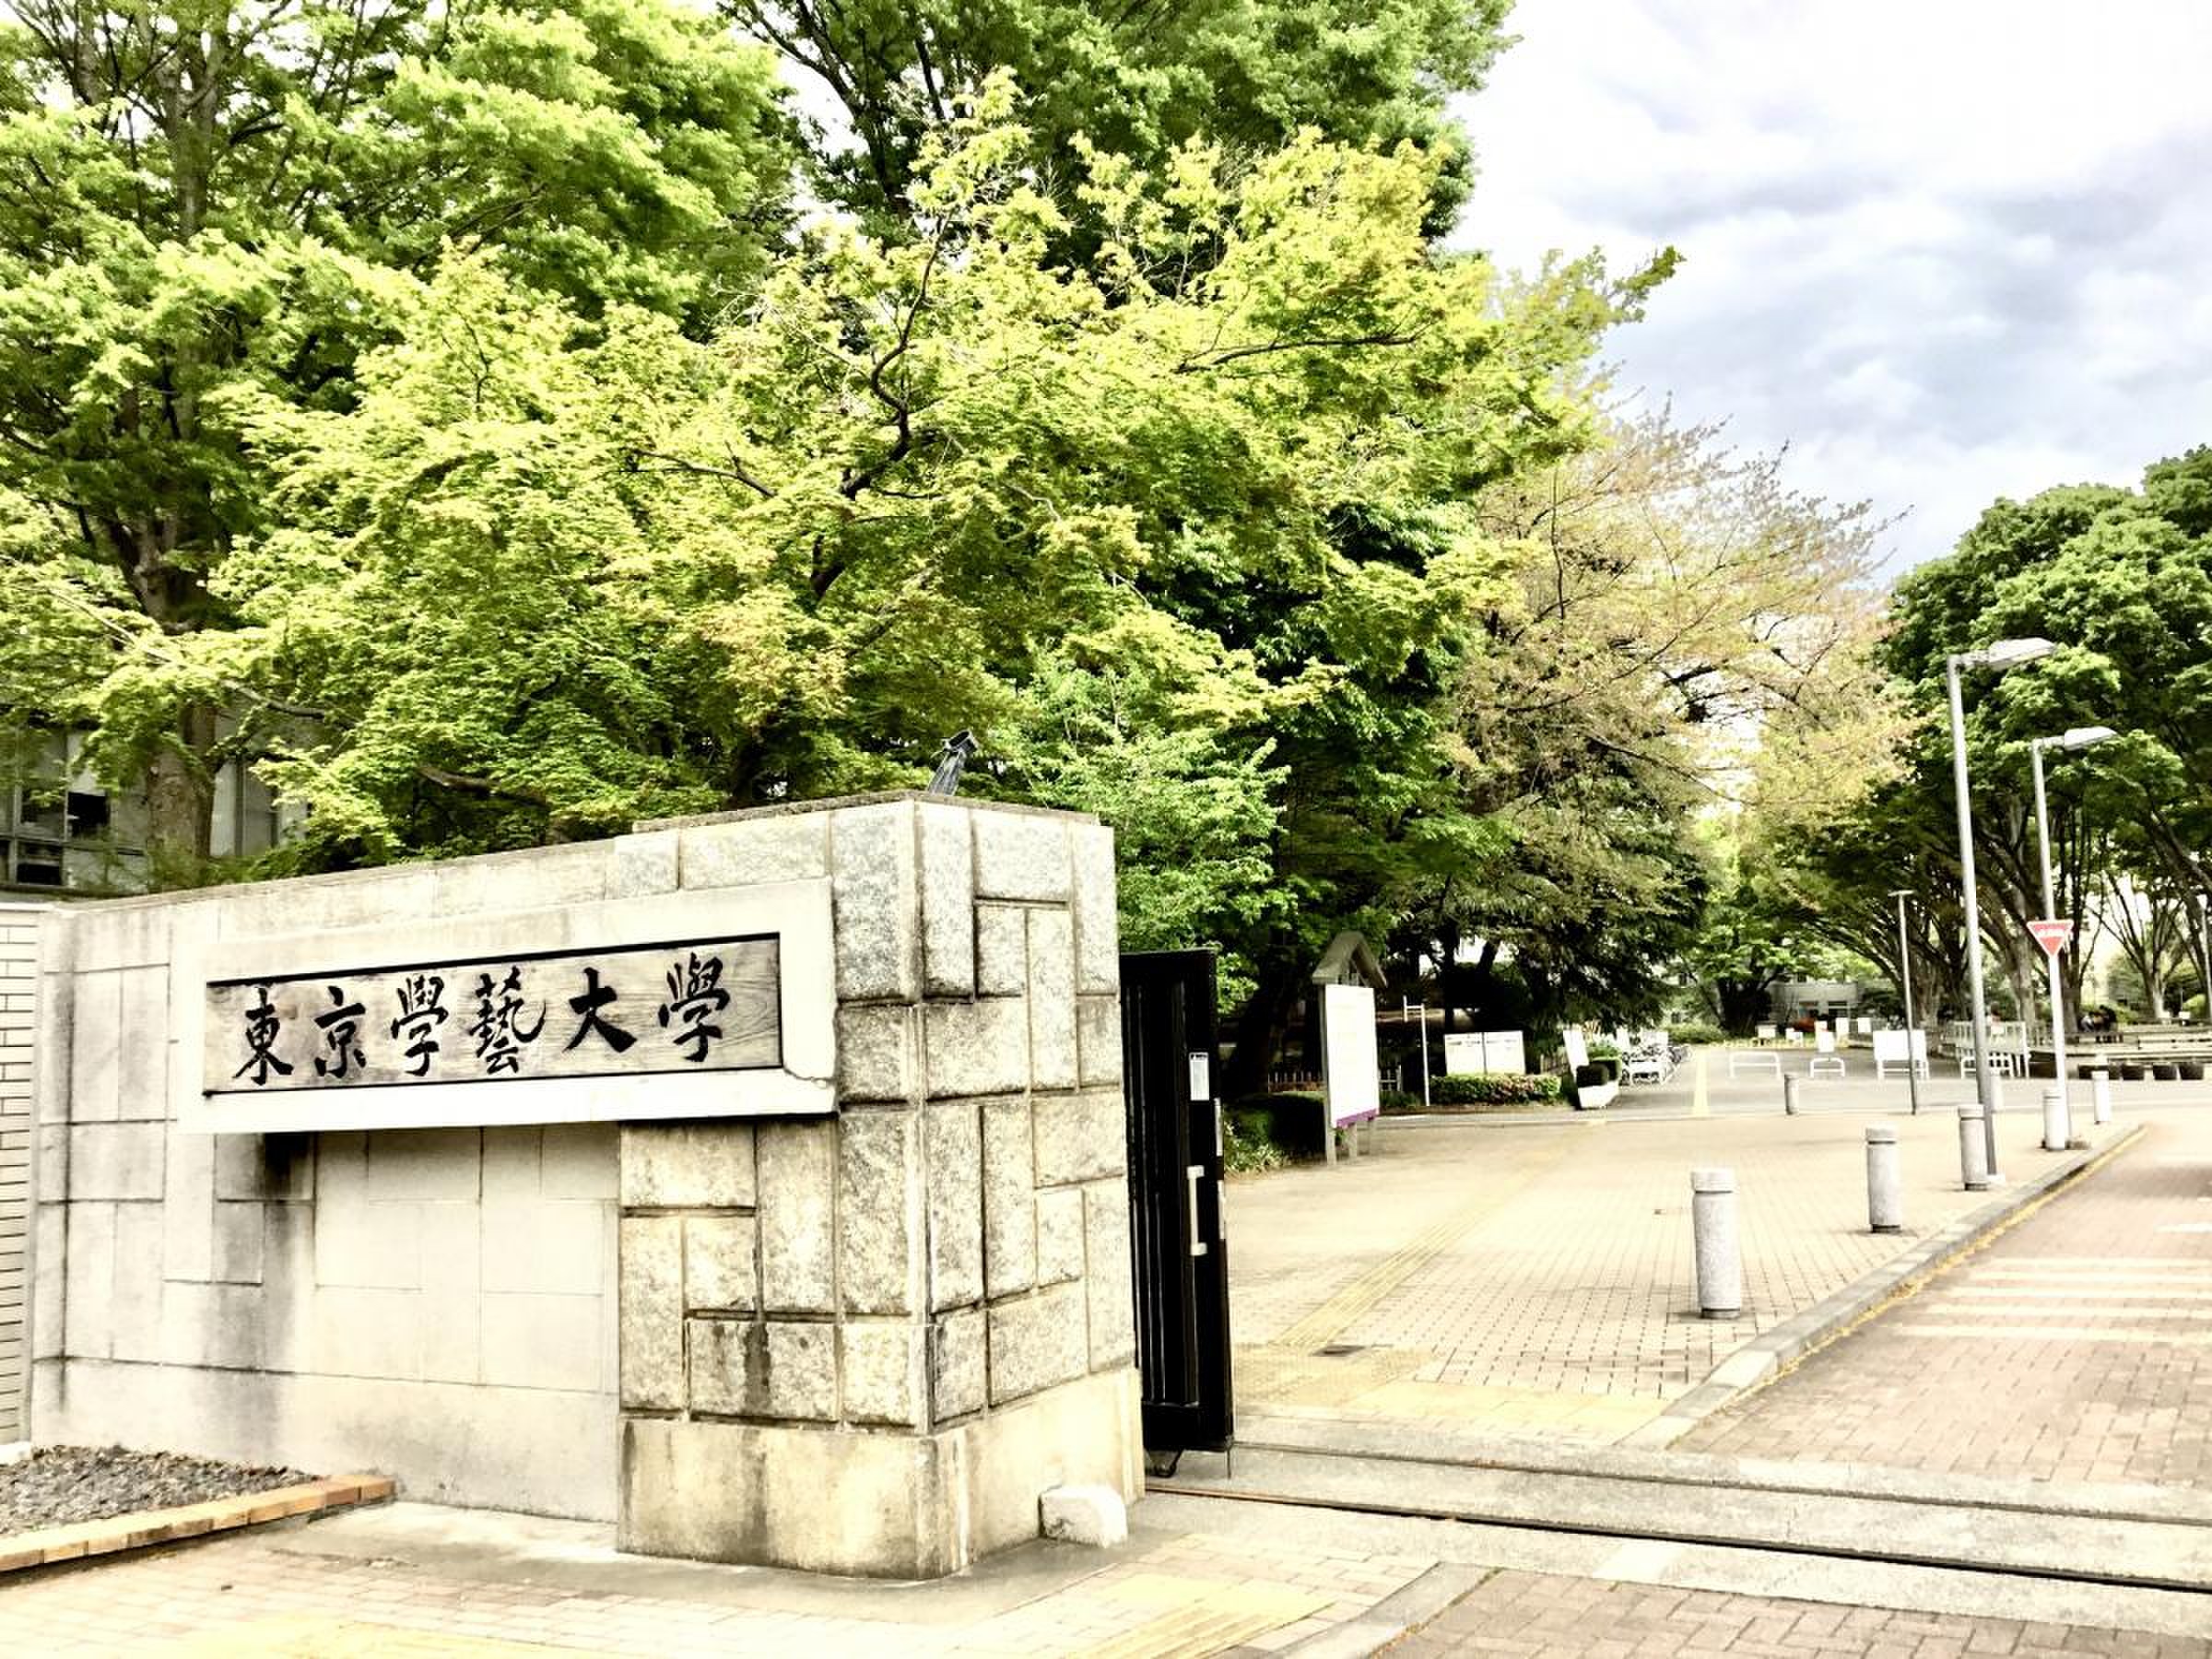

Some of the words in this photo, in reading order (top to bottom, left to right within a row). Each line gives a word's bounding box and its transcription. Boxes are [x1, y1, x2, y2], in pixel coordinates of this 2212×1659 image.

[233, 952, 731, 1086] 東京學藝大學
